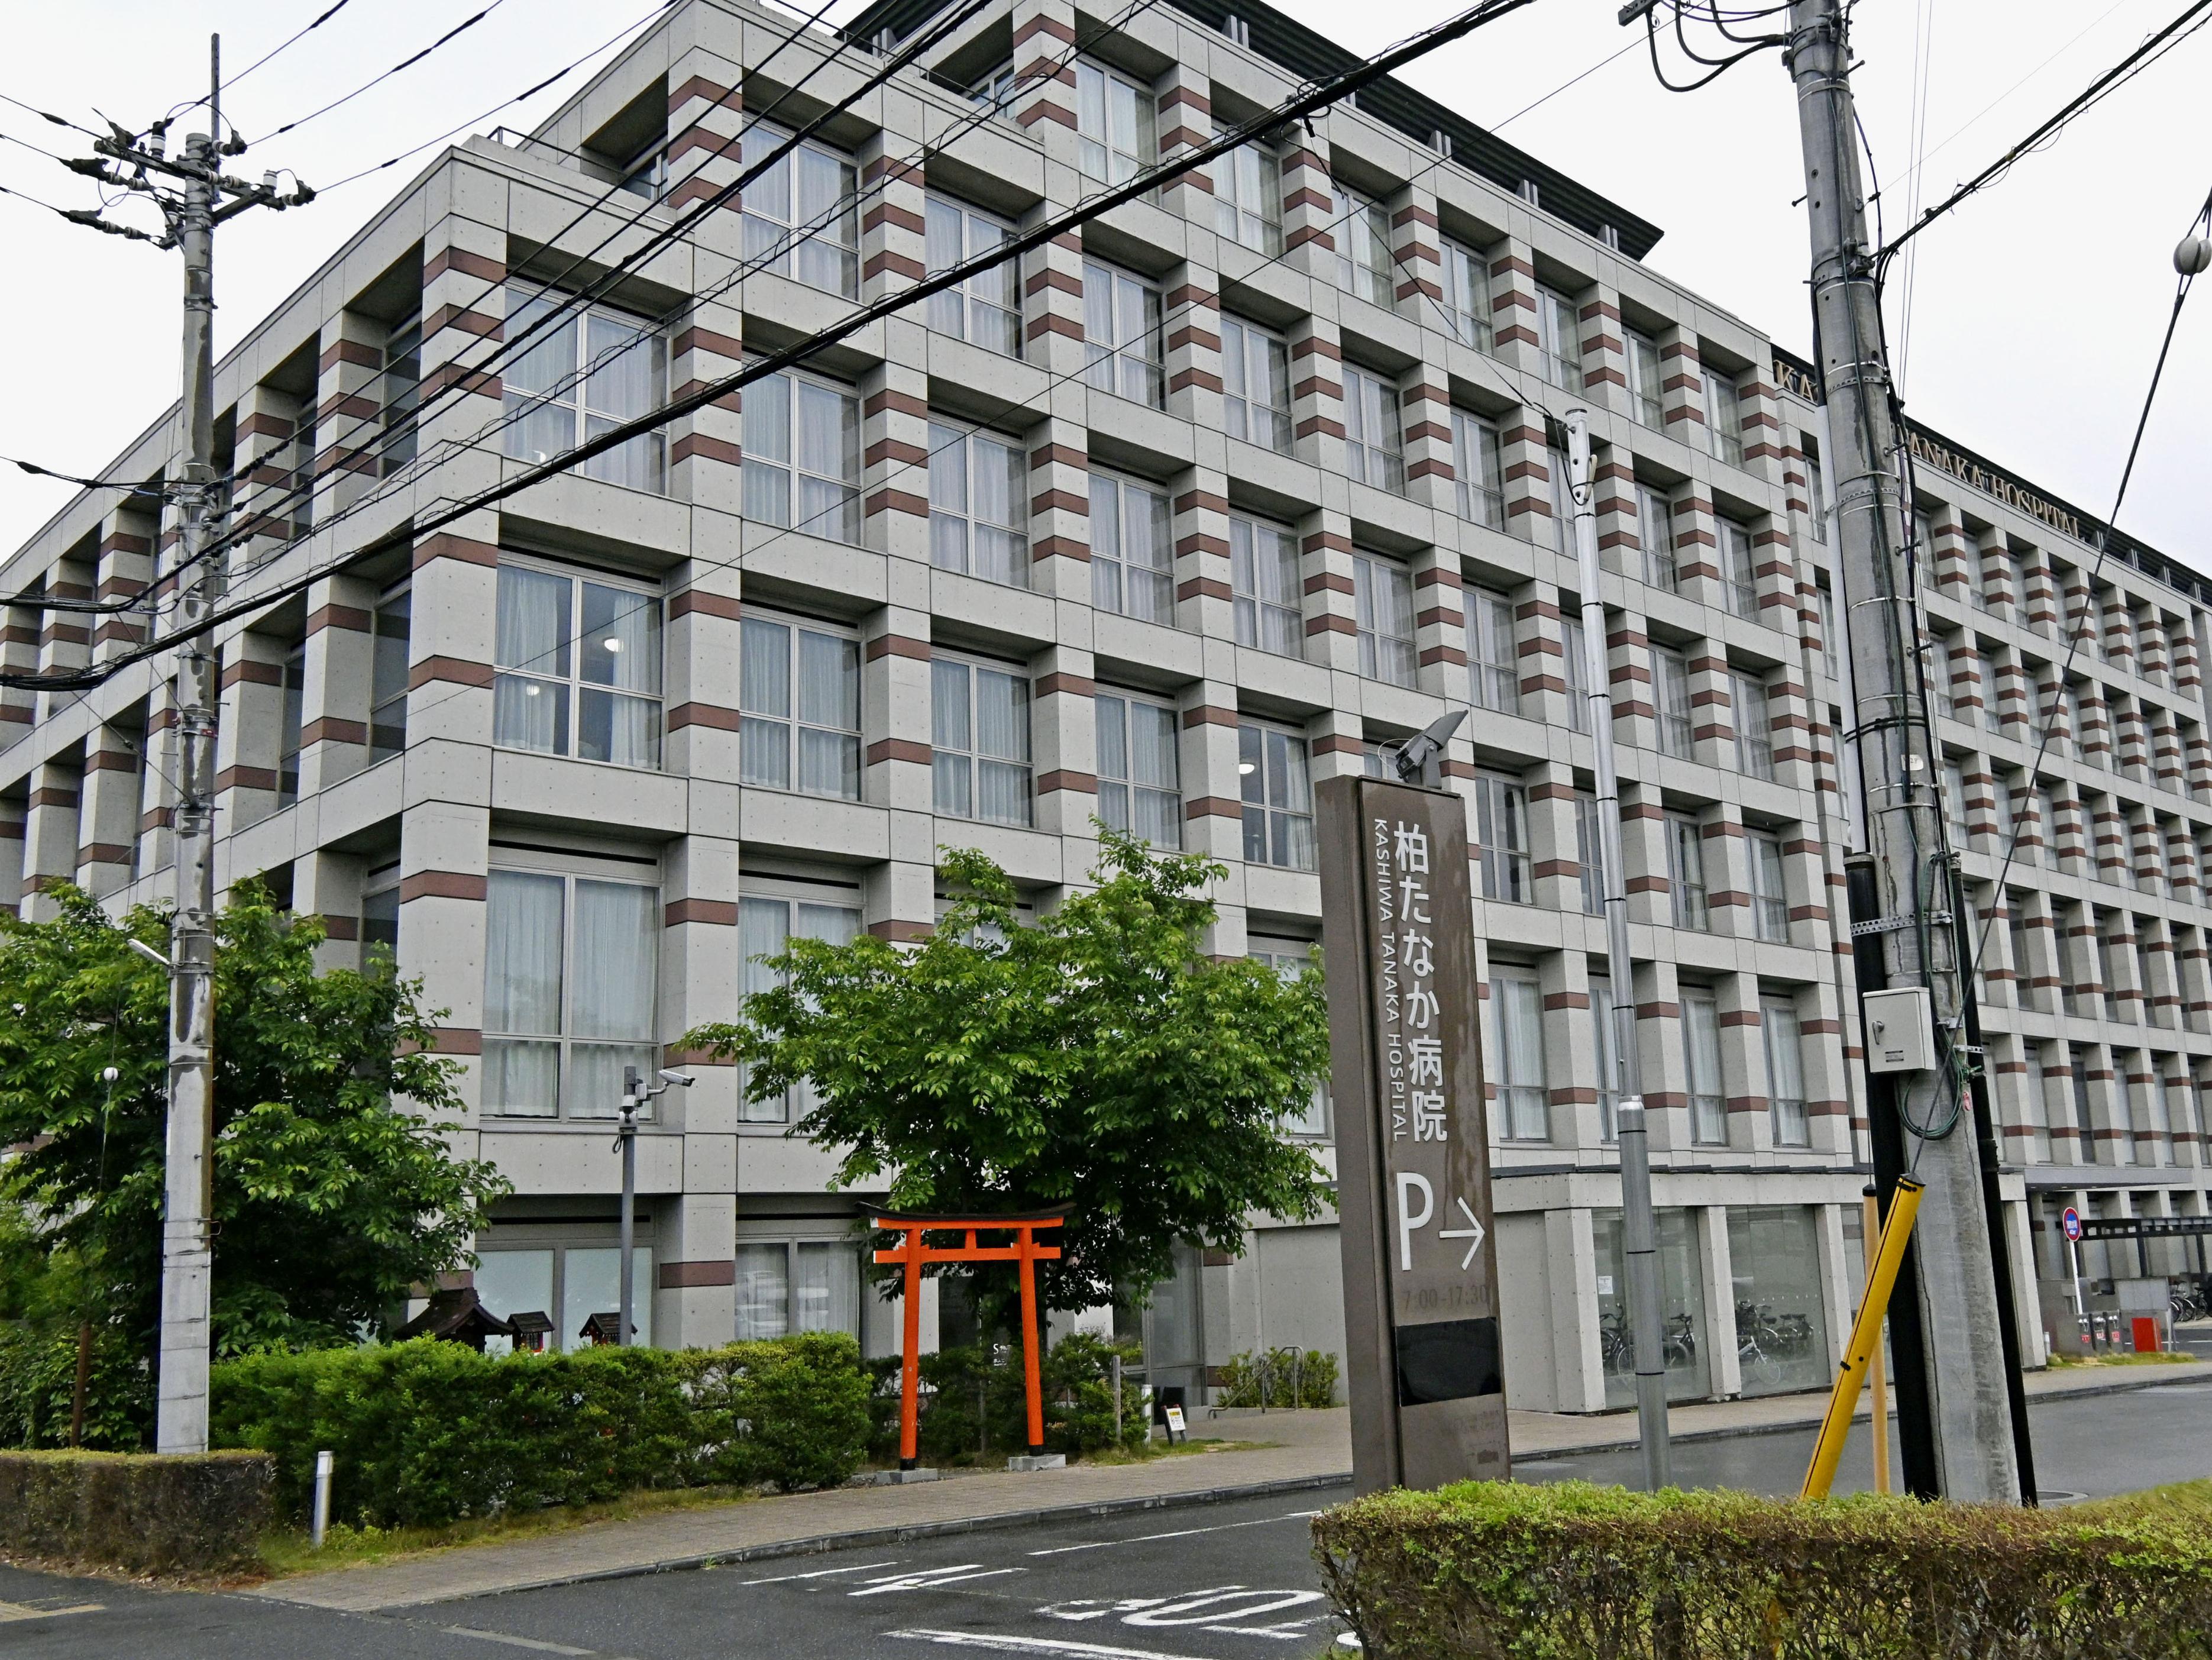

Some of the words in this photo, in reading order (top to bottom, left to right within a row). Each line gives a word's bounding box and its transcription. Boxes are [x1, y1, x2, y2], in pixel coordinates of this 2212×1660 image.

[1905, 428, 1984, 489] ANAKA
[1989, 473, 2085, 542] HOSPITAL
[1374, 819, 1393, 922] KASHIWA
[1382, 932, 1399, 1023] TANAKA
[1394, 821, 1447, 1142] 柏たなか病院
[1388, 1034, 1407, 1142] HOSPITAL
[1397, 1172, 1434, 1271] P
